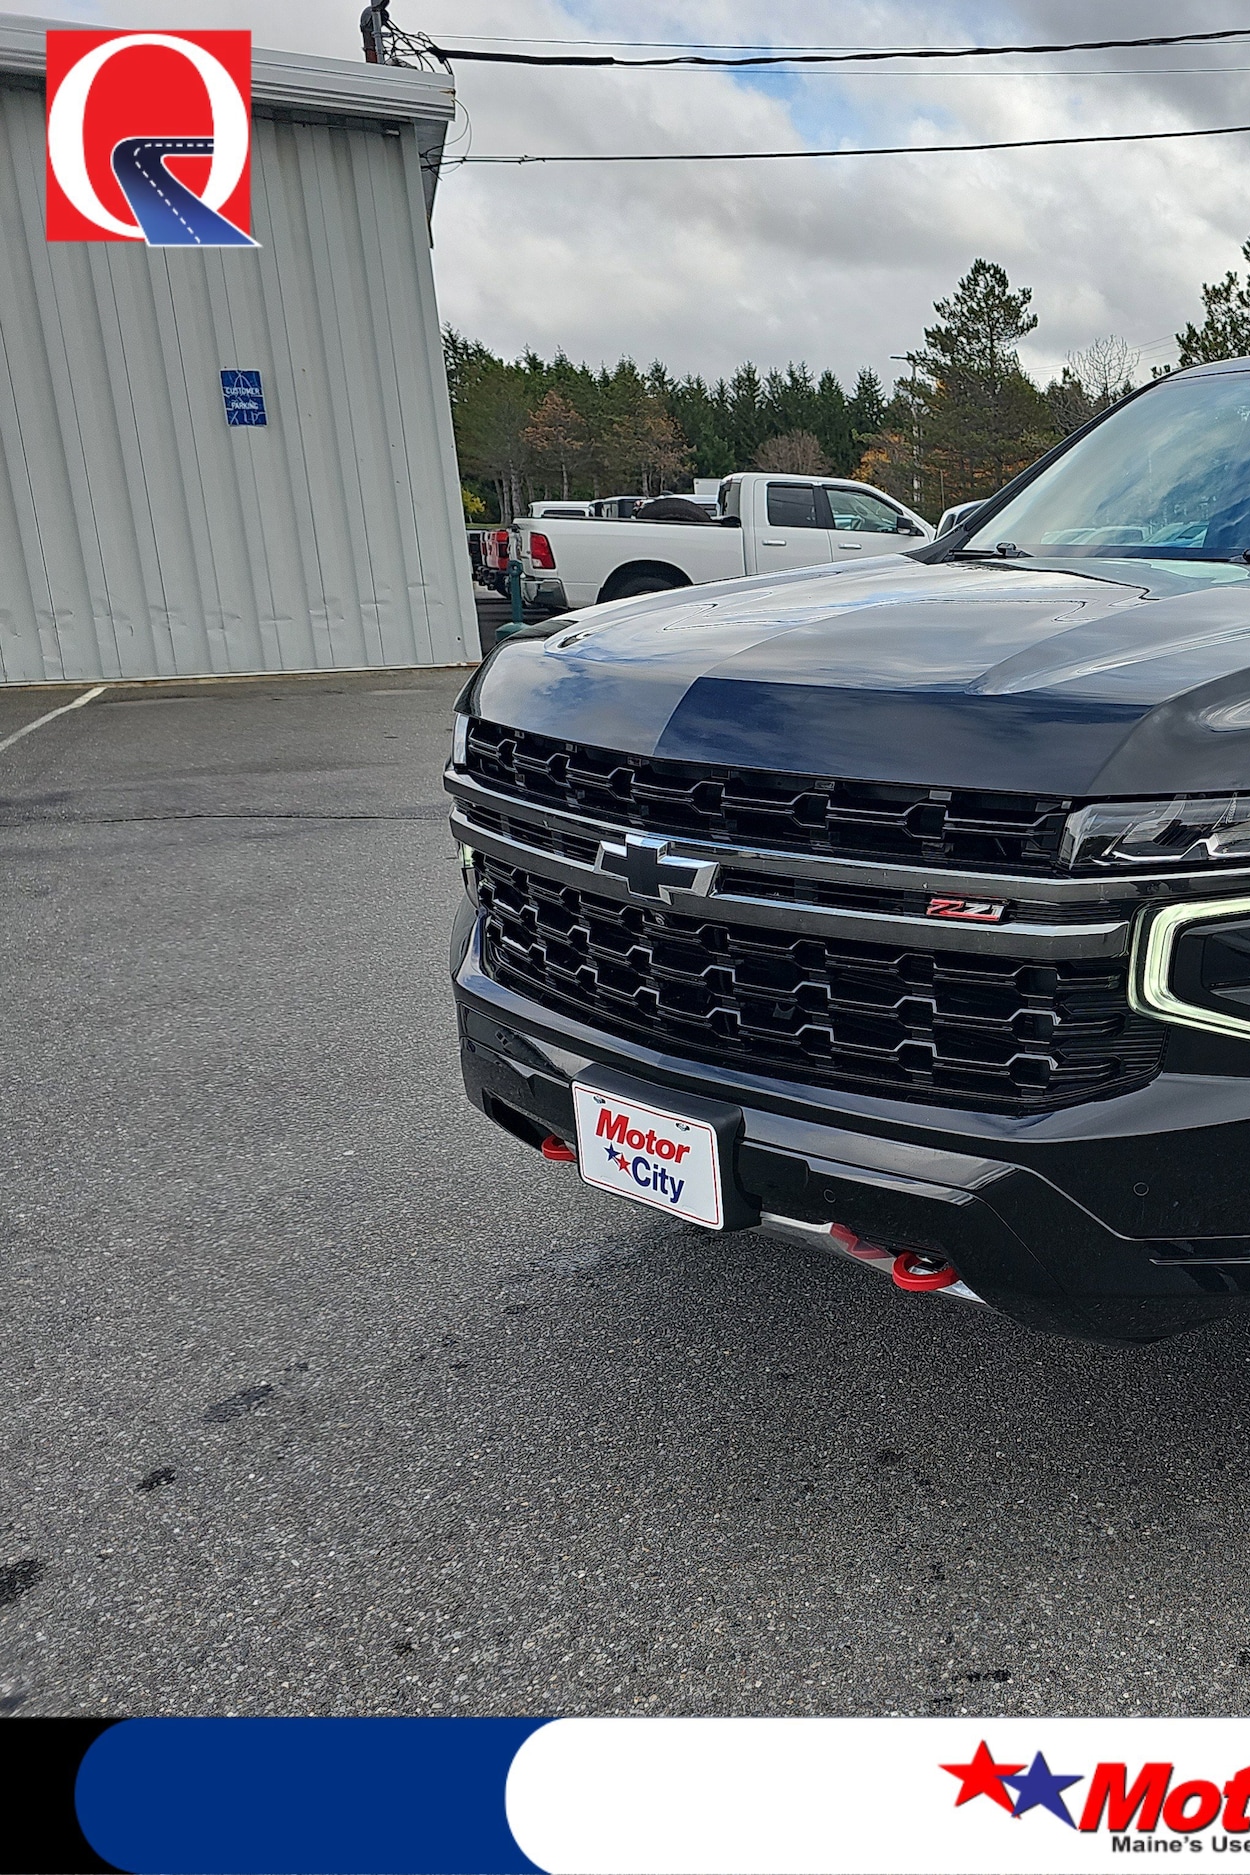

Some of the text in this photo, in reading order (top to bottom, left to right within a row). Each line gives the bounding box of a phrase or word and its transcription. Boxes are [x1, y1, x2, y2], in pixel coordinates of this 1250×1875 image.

[224, 386, 260, 395] CUSTOMER
[231, 400, 259, 410] PARKING
[595, 1108, 690, 1164] Motor
[631, 1156, 685, 1203] City
